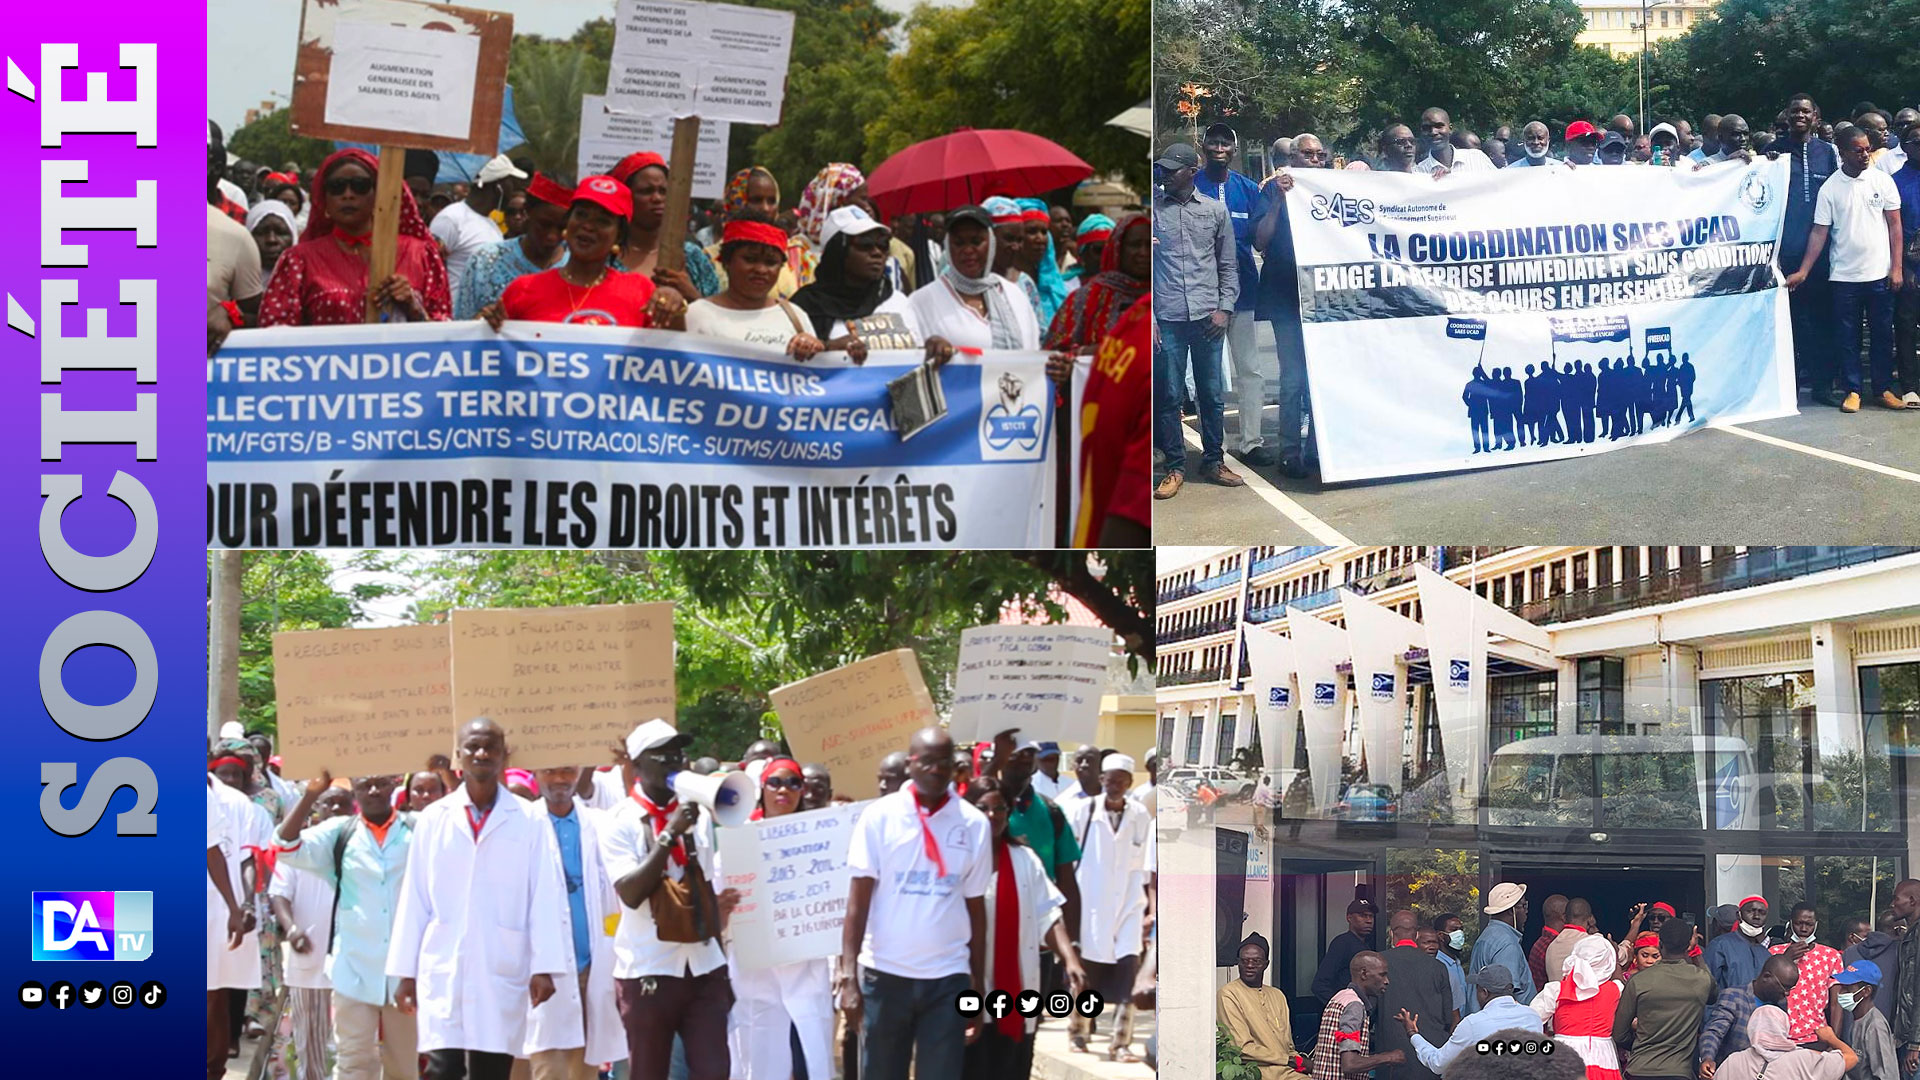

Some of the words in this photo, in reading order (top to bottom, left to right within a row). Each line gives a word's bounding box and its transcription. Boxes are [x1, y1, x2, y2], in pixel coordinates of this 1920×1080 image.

[370, 63, 434, 76] AUGMENTATION
[626, 67, 681, 79] AUGMENTATION
[419, 80, 434, 88] DES
[667, 81, 681, 89] DES
[713, 75, 767, 86] AUGMENTATION
[358, 85, 393, 96] SALAIRES
[394, 89, 409, 98] DES
[411, 91, 441, 101] AGENTS
[615, 87, 645, 97] SALAIRES
[646, 90, 659, 98] DES
[660, 92, 686, 101] AGENTS
[703, 95, 732, 105] SALAIRES
[747, 100, 772, 108] AGENTS
[1311, 193, 1375, 227] SAES
[1379, 205, 1406, 213] Syndicat
[1407, 205, 1438, 213] Autonome
[1438, 203, 1447, 211] de
[1408, 224, 1608, 263] COORDINATION
[1613, 221, 1674, 251] SAES
[1677, 215, 1741, 246] UCAD
[1314, 264, 1376, 291] EXIGE
[1380, 263, 1406, 288] LA
[1499, 257, 1607, 286] IMMEDIATE
[1609, 255, 1629, 278] ET
[1634, 250, 1679, 276] SANS
[1682, 241, 1773, 272] CONDITIONS
[1561, 285, 1584, 308] EN
[1589, 276, 1694, 306] PRESENTIEL
[862, 315, 896, 331] NOT
[516, 351, 590, 379] DES
[603, 353, 827, 397] TRAVAILLEURS
[436, 390, 705, 425] TERRITORIALES
[715, 403, 768, 430] DU
[352, 427, 511, 453] SNTCLS/CNTS
[531, 428, 690, 455] SUTRACOLS/FC
[704, 435, 843, 460] SUTMS/UNSAS
[292, 469, 512, 547] DÉFENDRE
[523, 480, 597, 549] LES
[609, 483, 744, 549] DROITS
[753, 485, 790, 547] ET
[798, 473, 958, 546] INTÉRÊTS
[294, 638, 383, 660] REGLEMENT
[515, 638, 596, 655] NAMORA
[513, 662, 560, 678] PREMIER
[569, 660, 622, 673] MINISTRE
